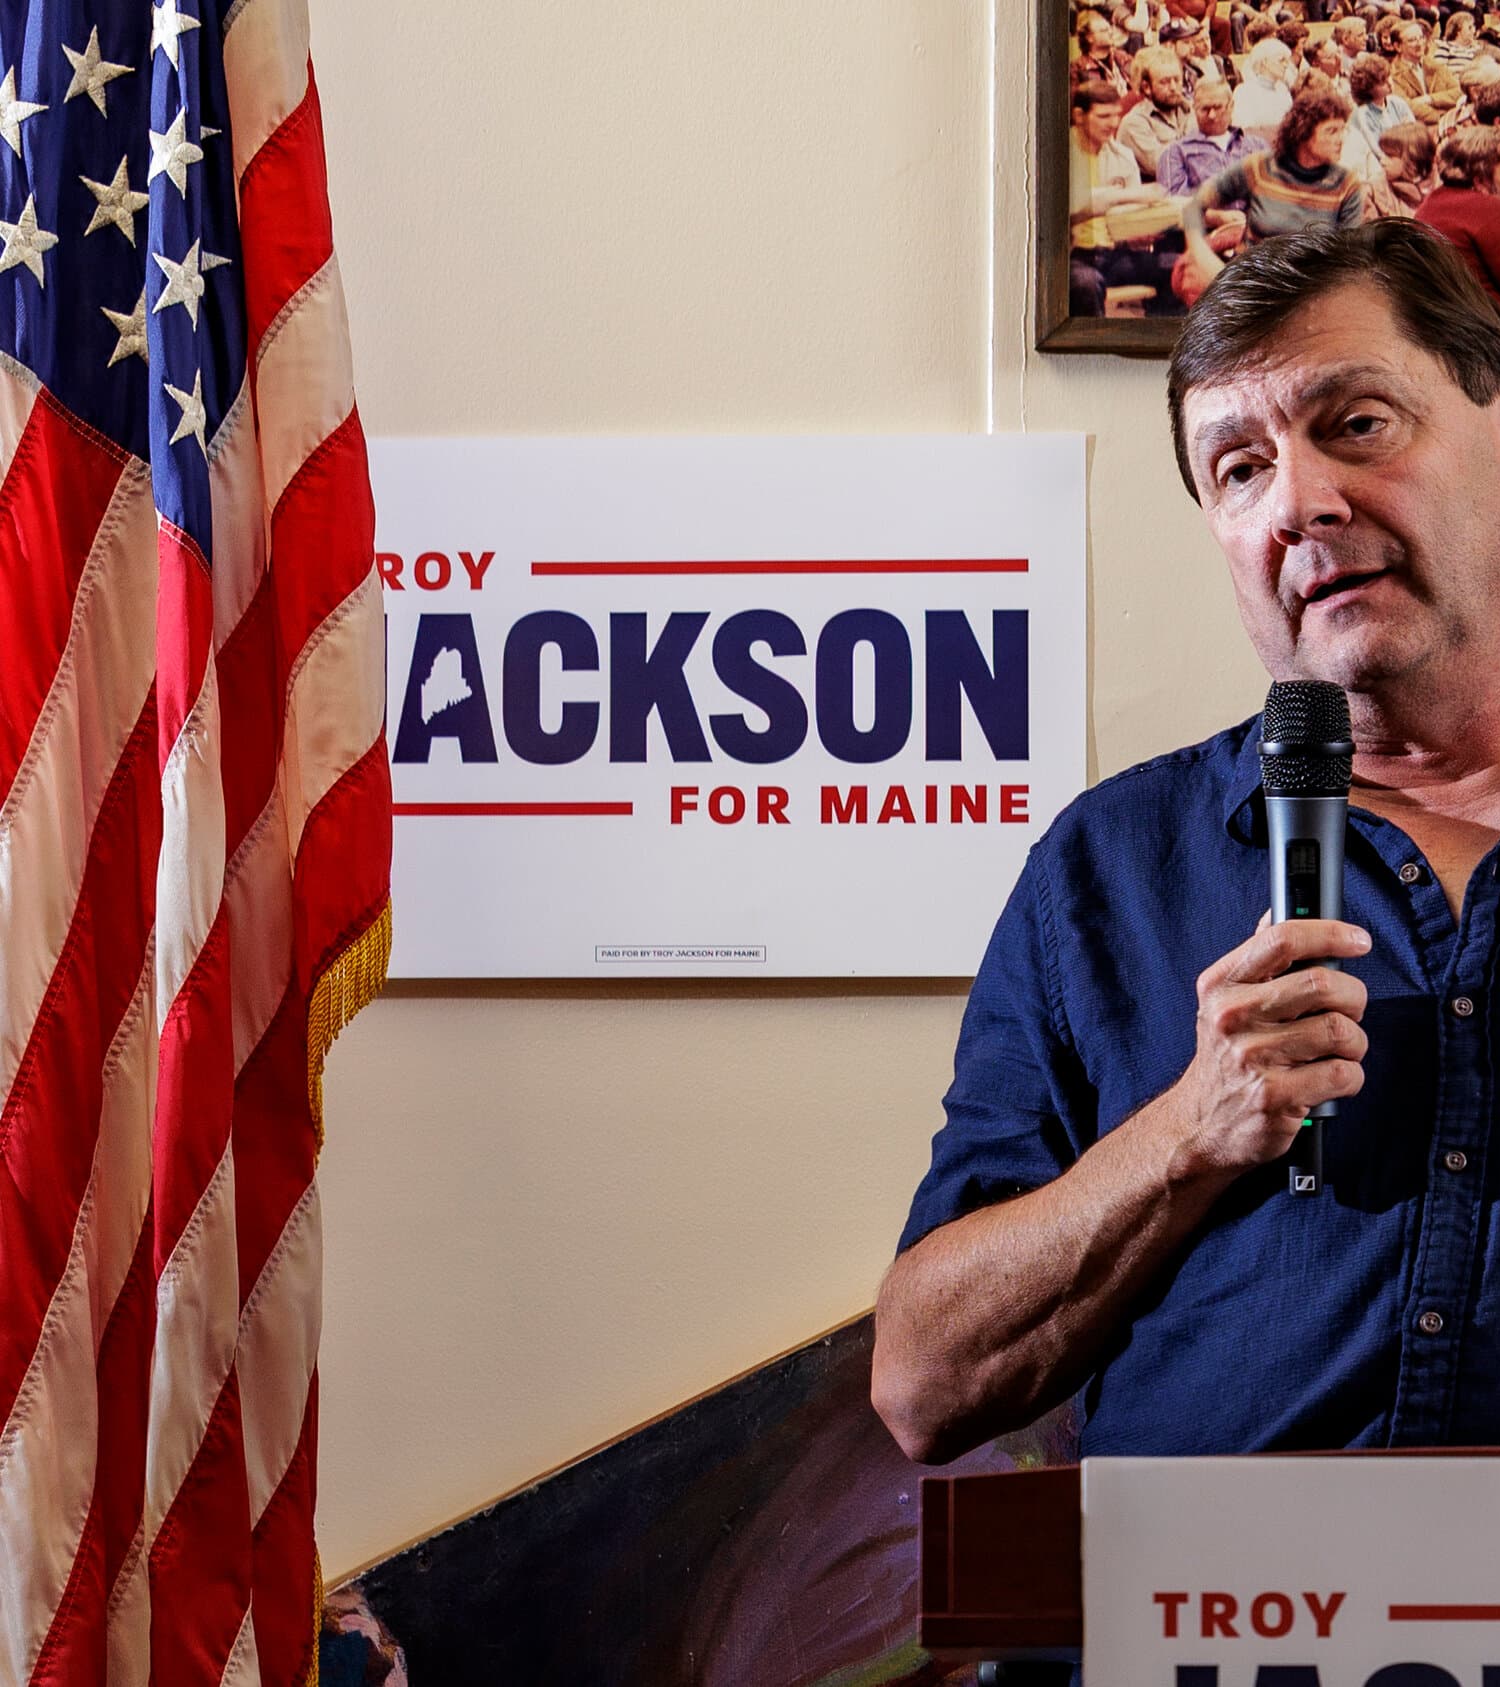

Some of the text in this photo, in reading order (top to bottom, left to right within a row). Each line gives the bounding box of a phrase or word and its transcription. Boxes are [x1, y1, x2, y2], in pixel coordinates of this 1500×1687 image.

[375, 551, 496, 591] ROY
[384, 608, 1030, 765] ACKSON
[670, 784, 1030, 825] FOR MAINE
[1153, 1591, 1347, 1639] TROY
